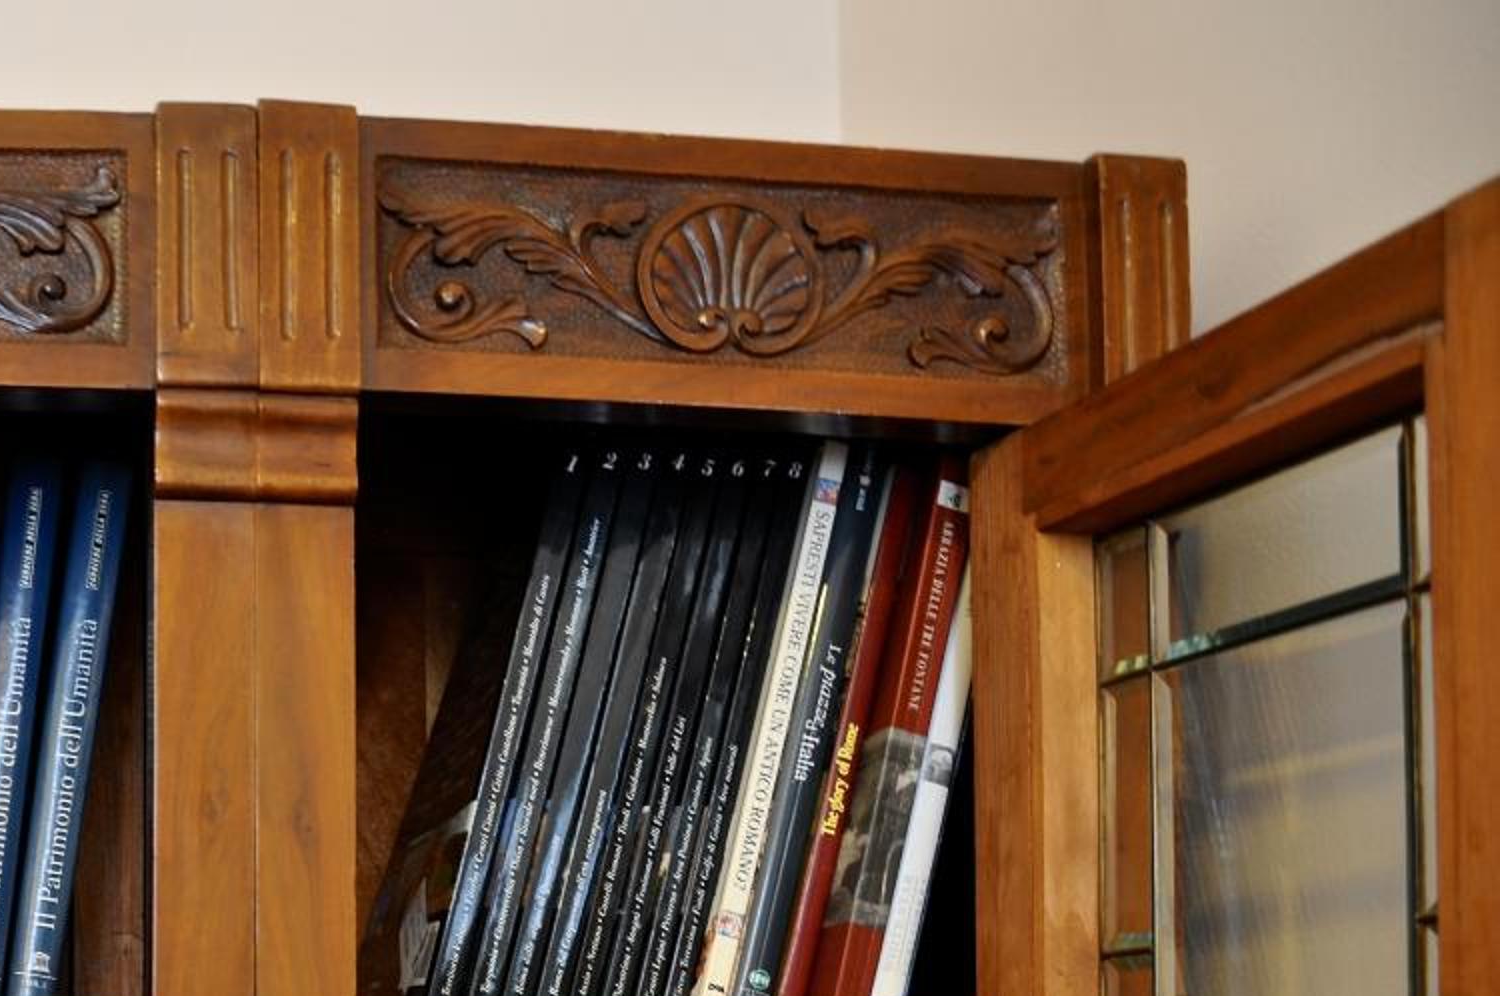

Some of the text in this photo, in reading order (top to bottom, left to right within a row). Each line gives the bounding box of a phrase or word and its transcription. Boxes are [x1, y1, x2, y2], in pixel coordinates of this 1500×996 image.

[567, 455, 579, 472] 1
[602, 452, 617, 470] 2
[637, 453, 652, 470] 3
[701, 459, 716, 477] 5
[731, 461, 744, 477] 6
[763, 459, 777, 477] 7
[788, 461, 802, 479] 8
[907, 519, 954, 712] ABBAZIA DELLE TRE FONTANE
[811, 643, 843, 727] Le piazze
[731, 509, 831, 892] SAPRESTI VIVERE COME UN ANTICO ROMANO?
[32, 617, 99, 930] Il Patrimonio dell'Umanità
[820, 719, 861, 836] The glory of Rome
[605, 842, 623, 880] Romani
[615, 806, 631, 835] Tivoli
[547, 967, 565, 996] Roma
